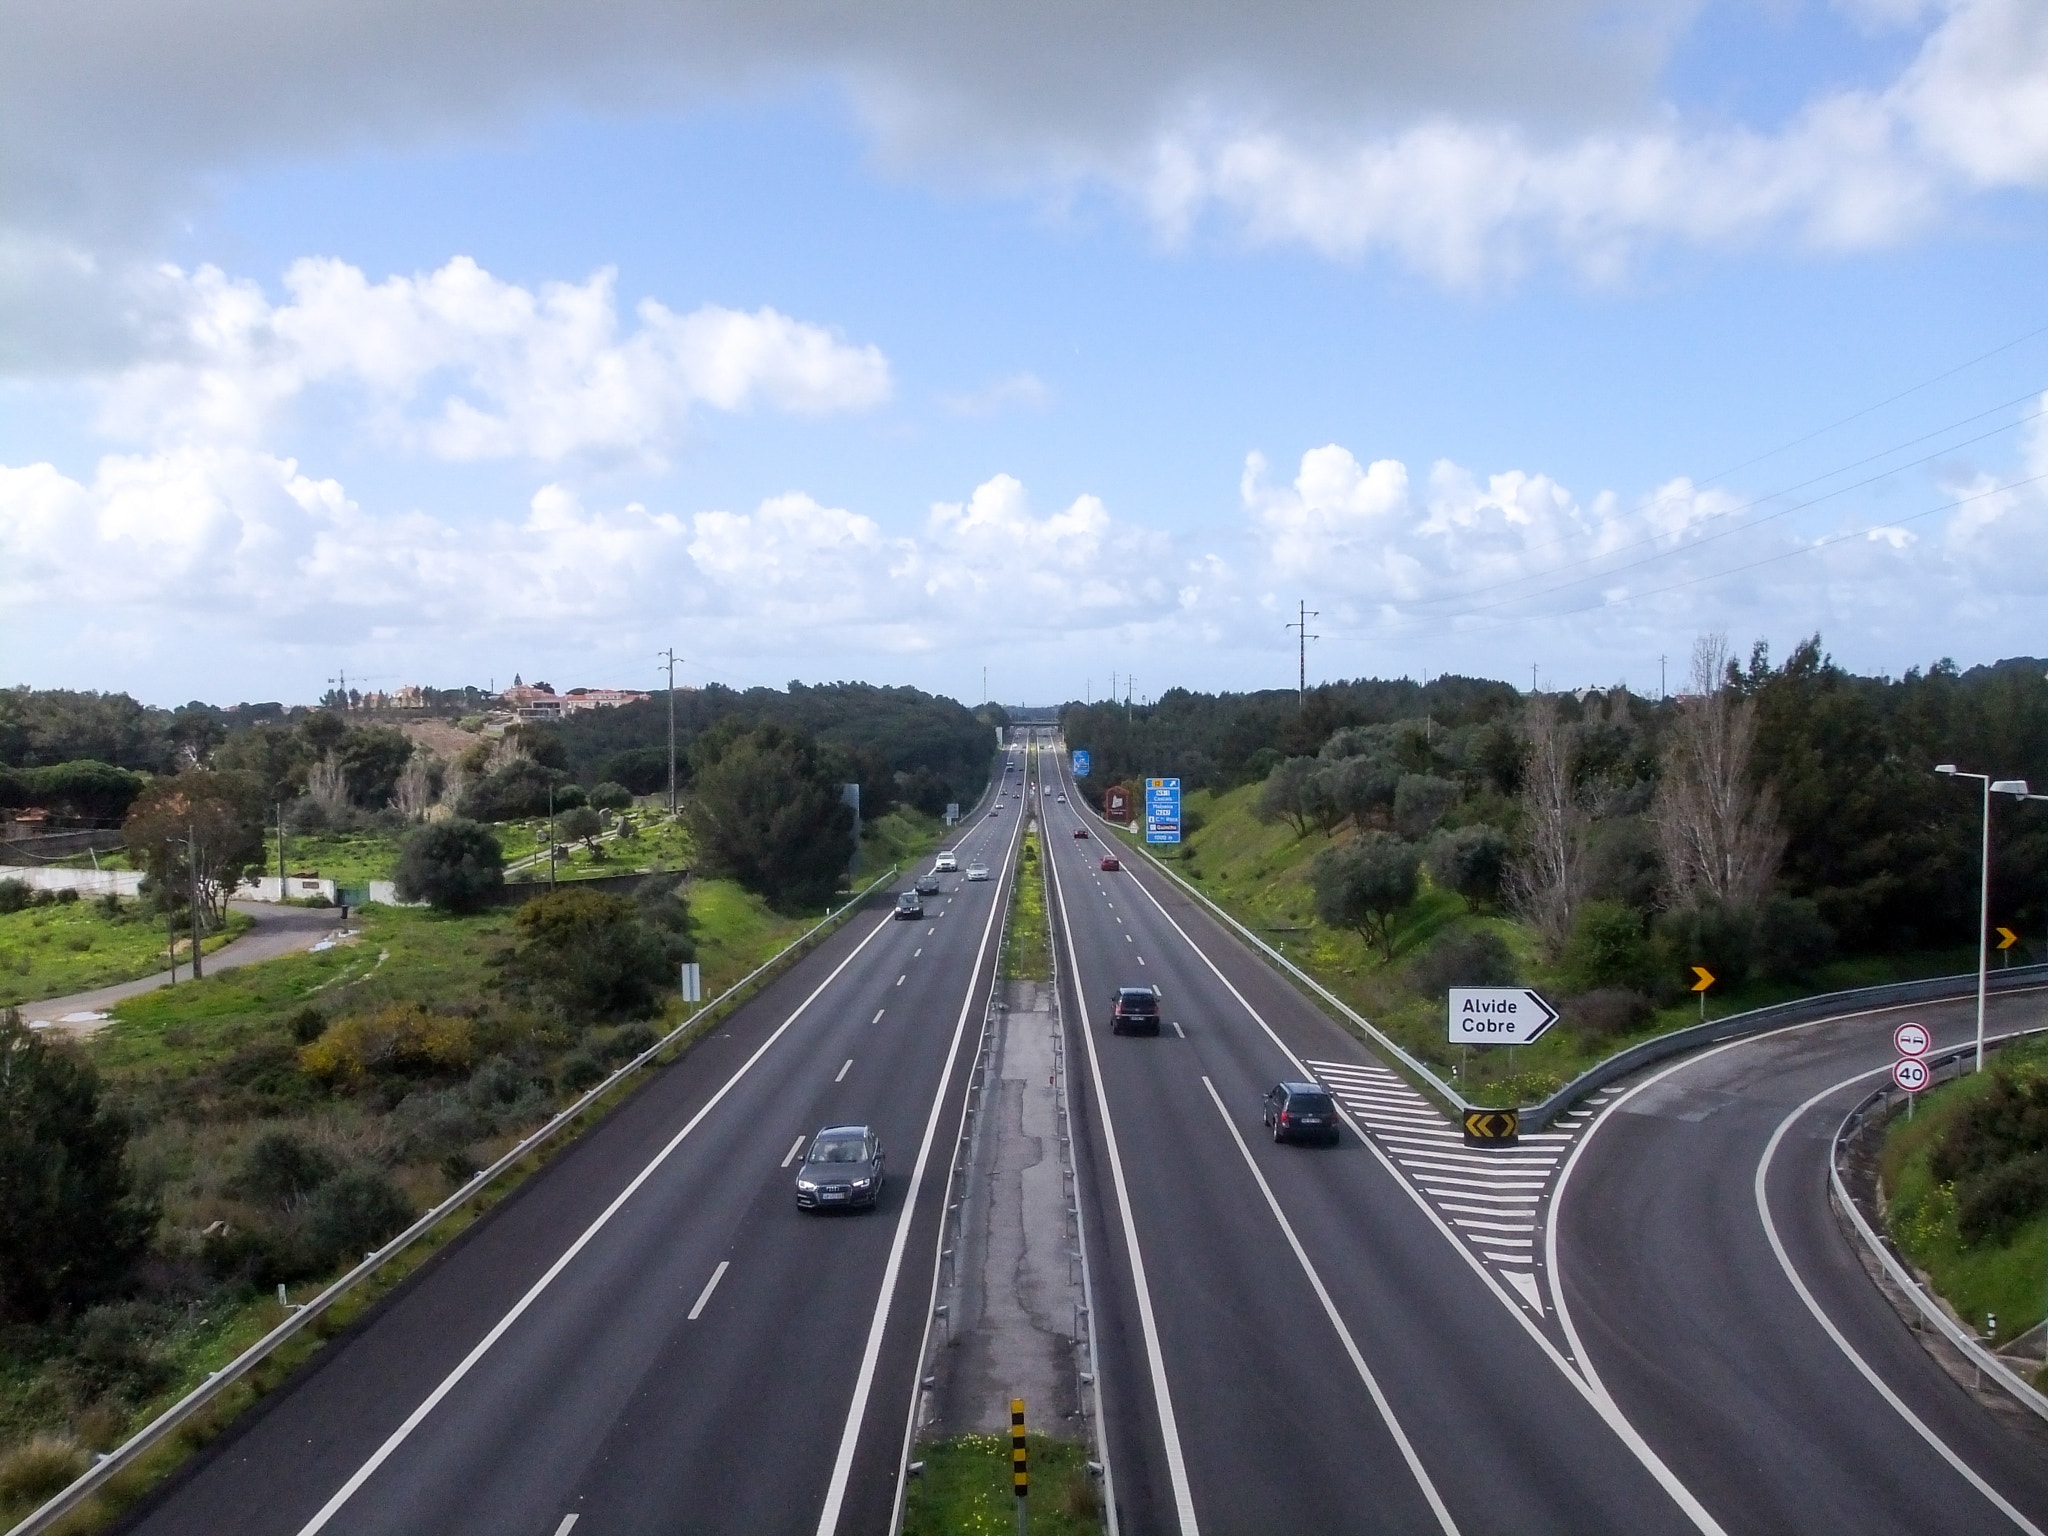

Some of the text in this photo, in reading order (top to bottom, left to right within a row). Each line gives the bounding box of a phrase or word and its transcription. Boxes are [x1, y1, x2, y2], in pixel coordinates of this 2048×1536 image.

[1462, 999, 1517, 1013] Alvide
[1462, 1018, 1516, 1033] Cobre
[1899, 1068, 1922, 1081] 40
